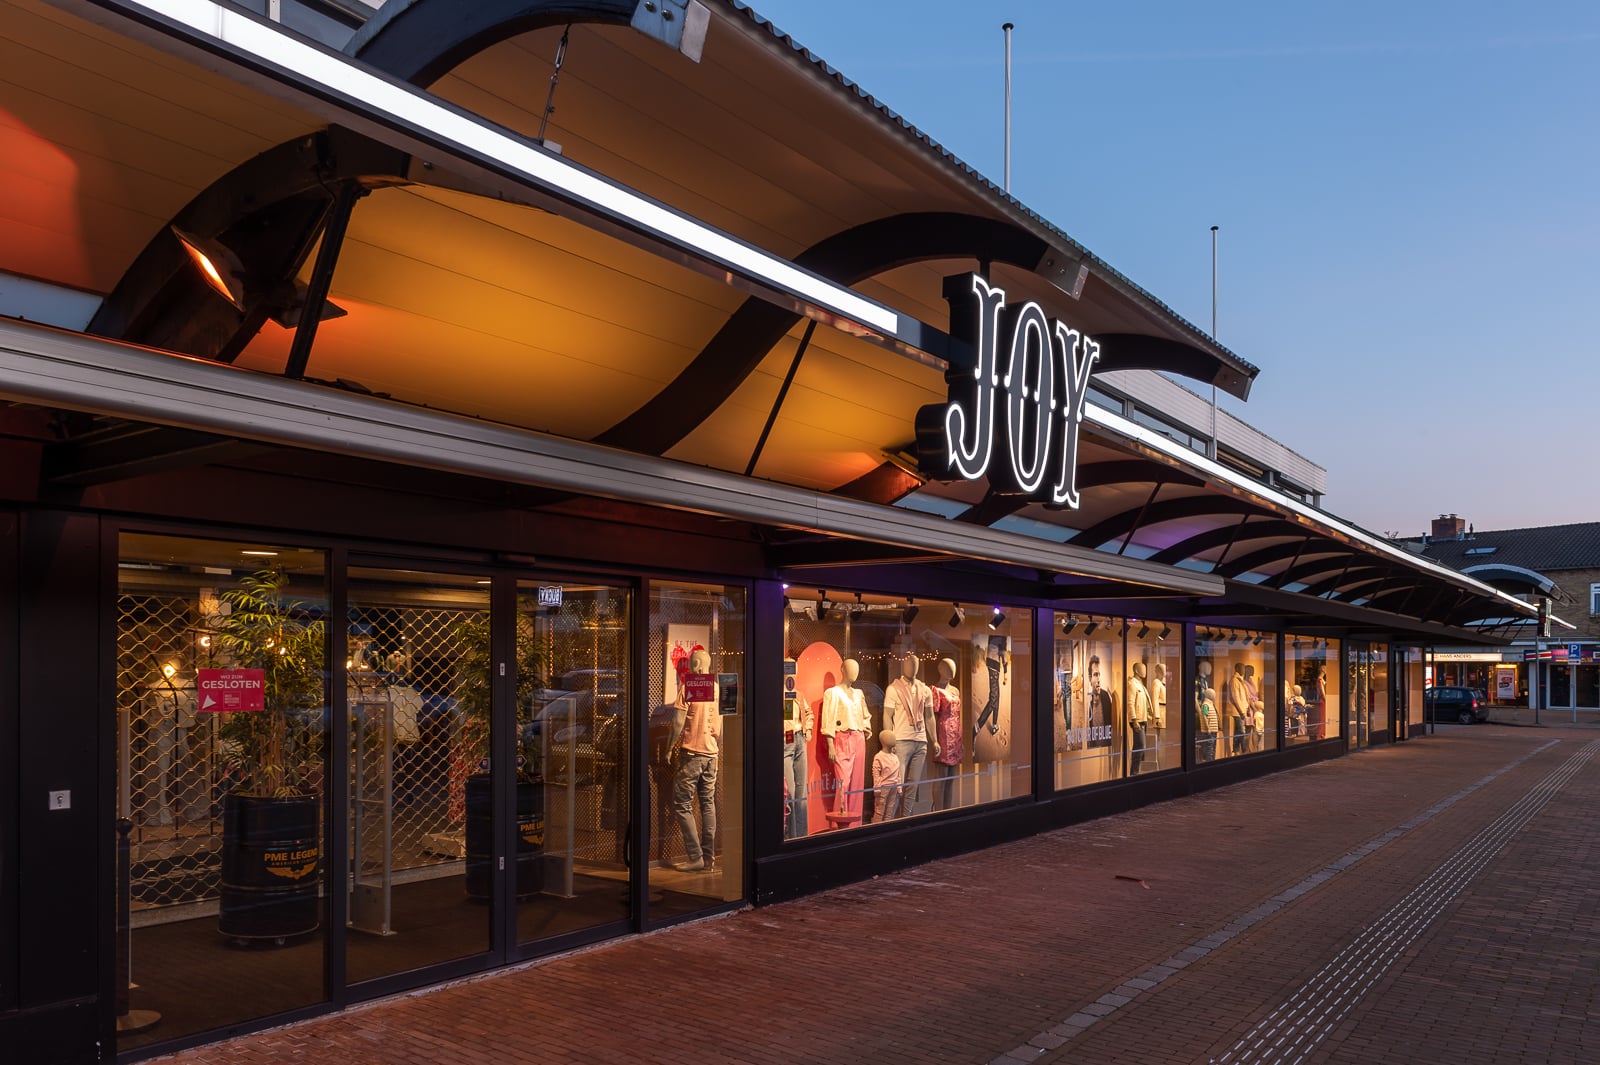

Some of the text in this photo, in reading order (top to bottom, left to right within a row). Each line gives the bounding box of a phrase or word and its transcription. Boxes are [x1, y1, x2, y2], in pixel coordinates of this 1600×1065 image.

[945, 274, 1100, 509] JOY
[1570, 645, 1578, 653] P
[201, 680, 261, 689] GESLOTEN
[263, 852, 289, 861] PME
